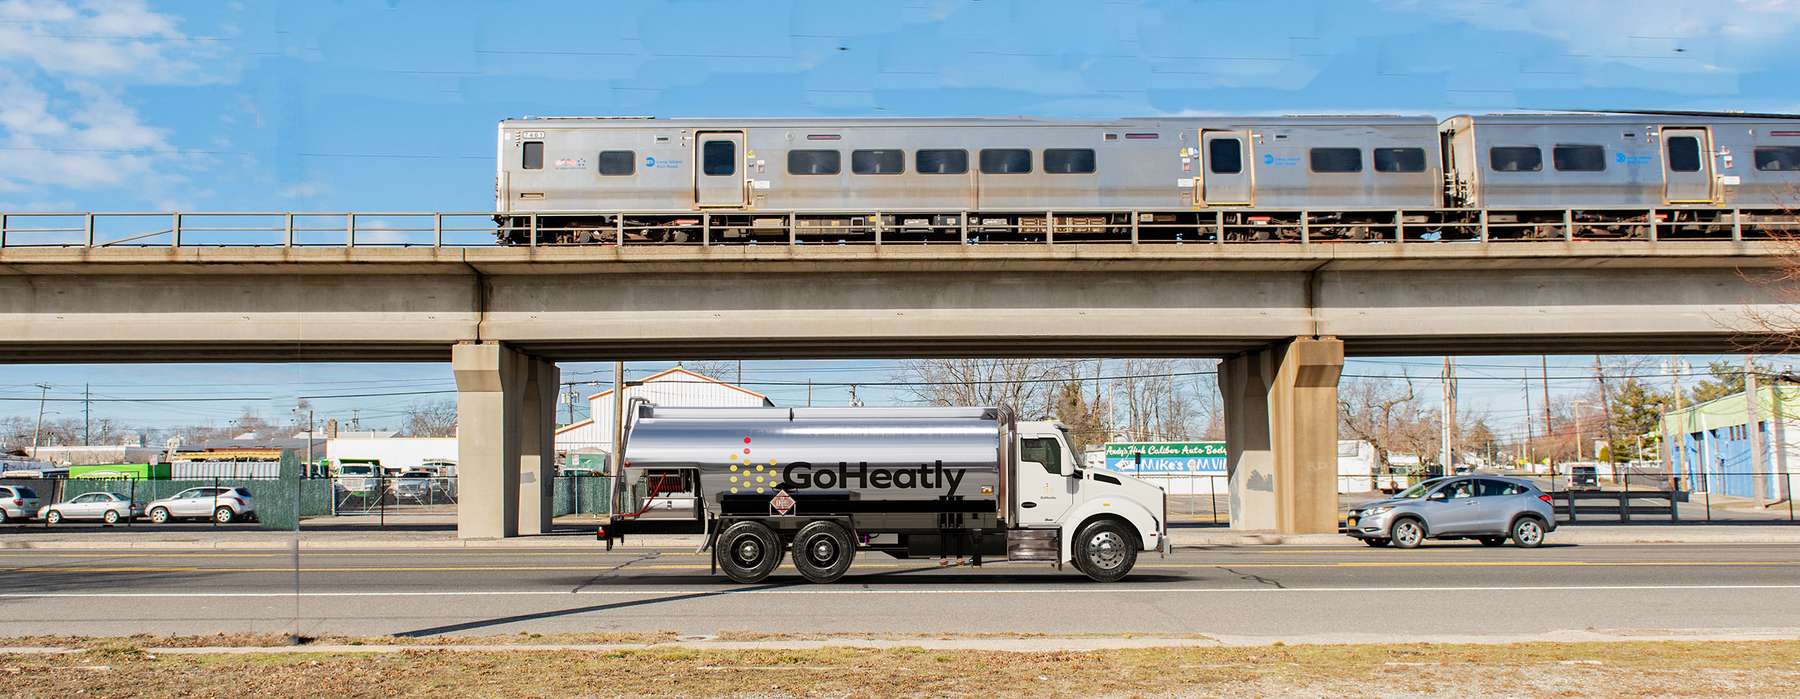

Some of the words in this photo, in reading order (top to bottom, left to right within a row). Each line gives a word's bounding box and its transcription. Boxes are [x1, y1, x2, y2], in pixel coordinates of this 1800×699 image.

[1147, 445, 1181, 455] Caliber
[1181, 445, 1204, 455] Auto
[783, 460, 966, 496] GoHeatly
